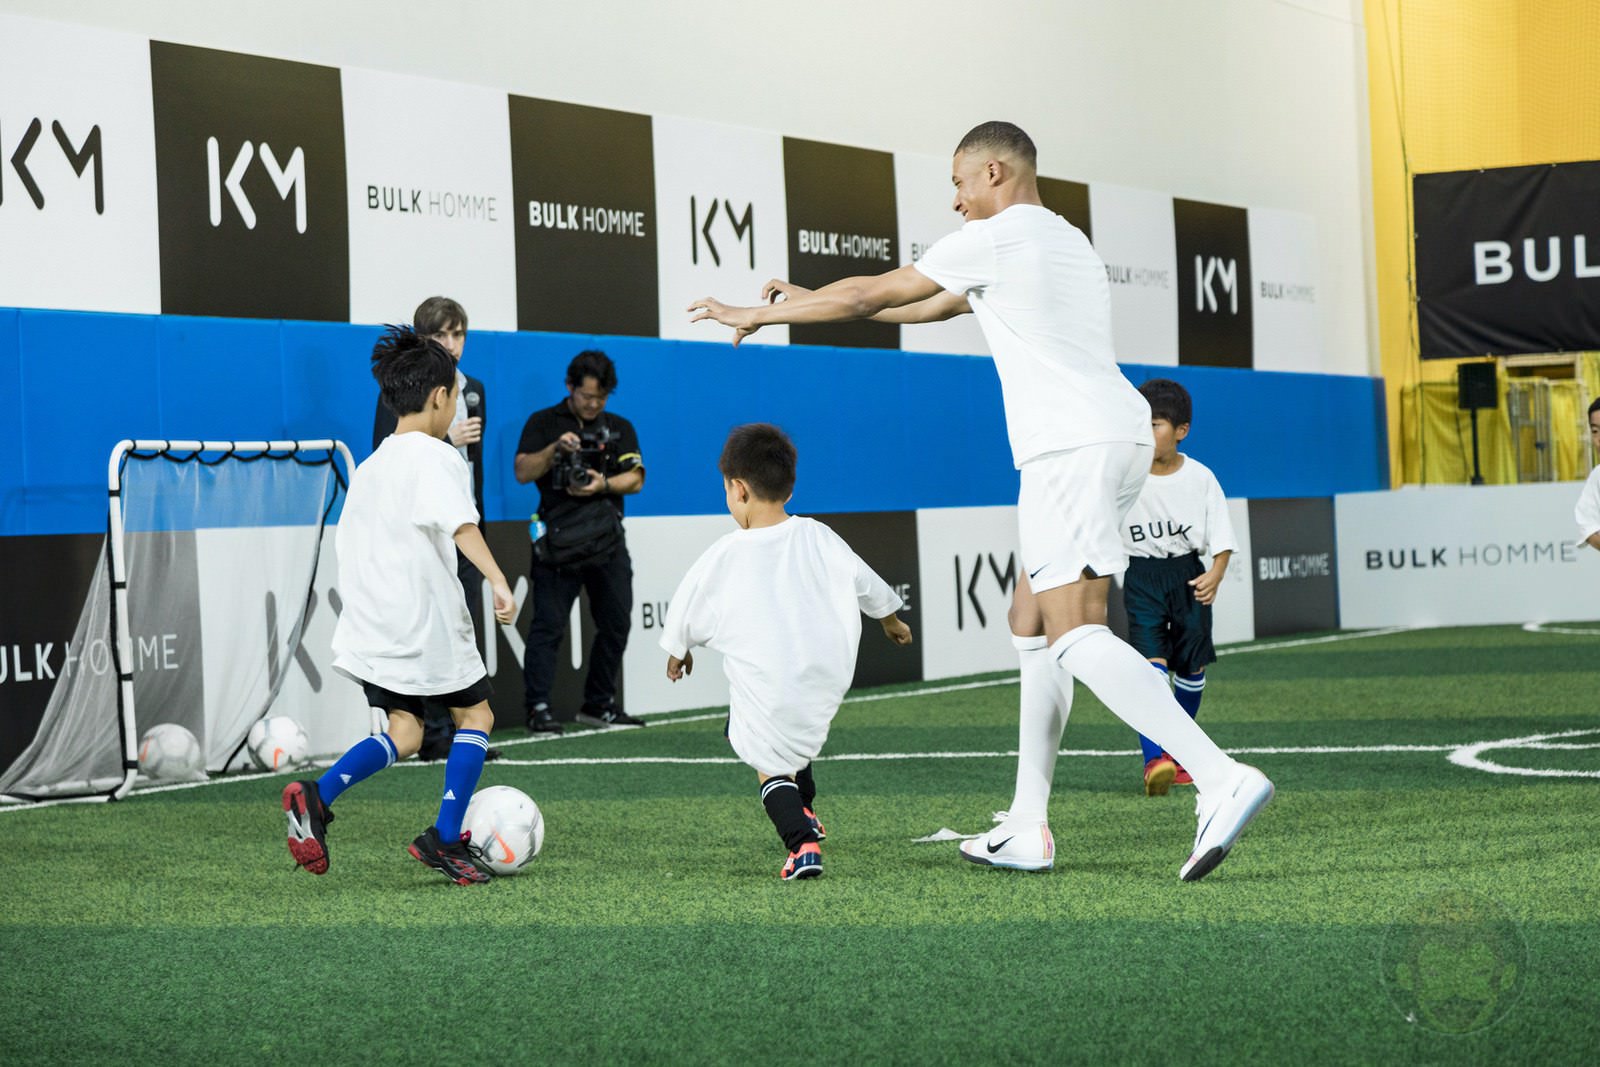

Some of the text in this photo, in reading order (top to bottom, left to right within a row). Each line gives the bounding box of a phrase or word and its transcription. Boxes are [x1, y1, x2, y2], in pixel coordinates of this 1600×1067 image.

[207, 136, 307, 234] KM
[367, 185, 498, 222] BULK HOMME
[528, 200, 645, 238] BULK HOMME
[691, 195, 755, 270] KM
[797, 229, 892, 261] BULK HOMME
[1473, 234, 1600, 285] BUL
[1195, 254, 1238, 315] KM
[1129, 520, 1192, 542] BULK
[1258, 555, 1291, 580] BULK
[1365, 540, 1577, 570] BULK HOMME
[955, 551, 1017, 631] KM
